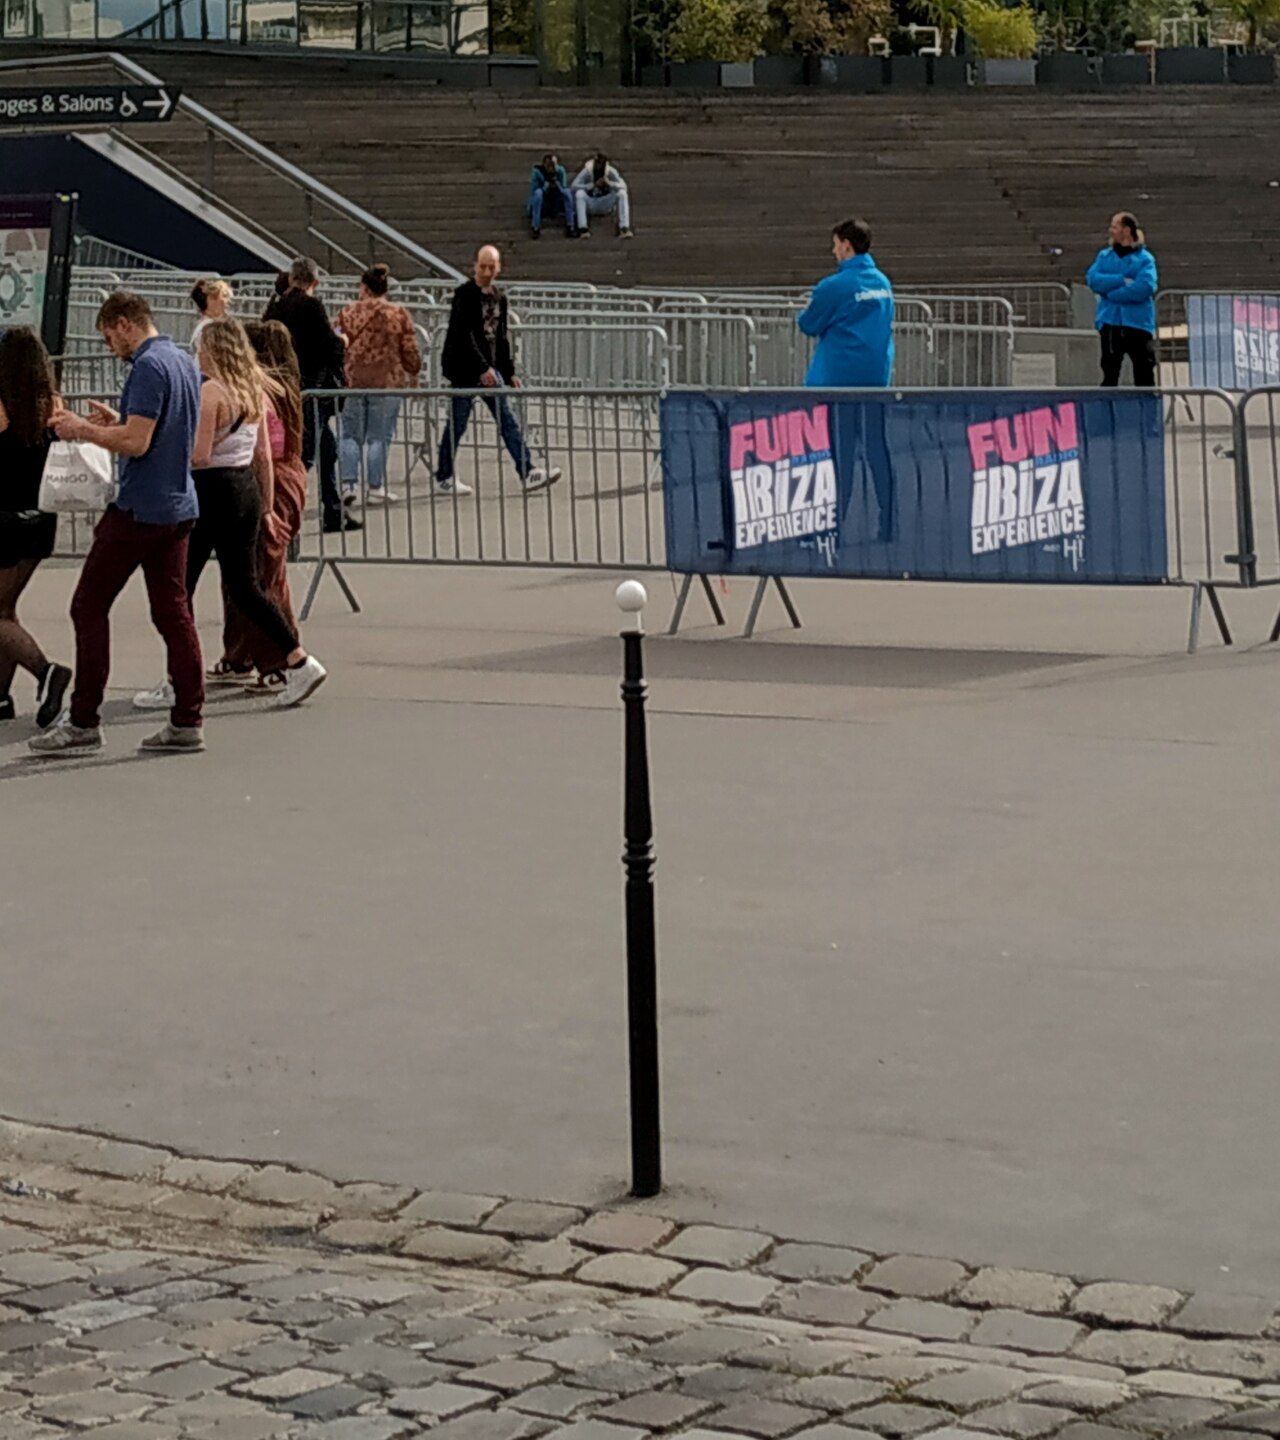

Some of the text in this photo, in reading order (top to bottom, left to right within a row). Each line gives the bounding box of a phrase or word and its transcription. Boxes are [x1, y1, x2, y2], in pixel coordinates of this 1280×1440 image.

[41, 94, 55, 112] &
[58, 94, 114, 112] Salons
[730, 404, 830, 471] FUN
[967, 402, 1079, 471] FUN
[1034, 448, 1079, 468] RADIO
[47, 473, 88, 483] MANGO
[735, 504, 837, 549] EXPERIENCE
[971, 504, 1085, 555] EXPERIENCE
